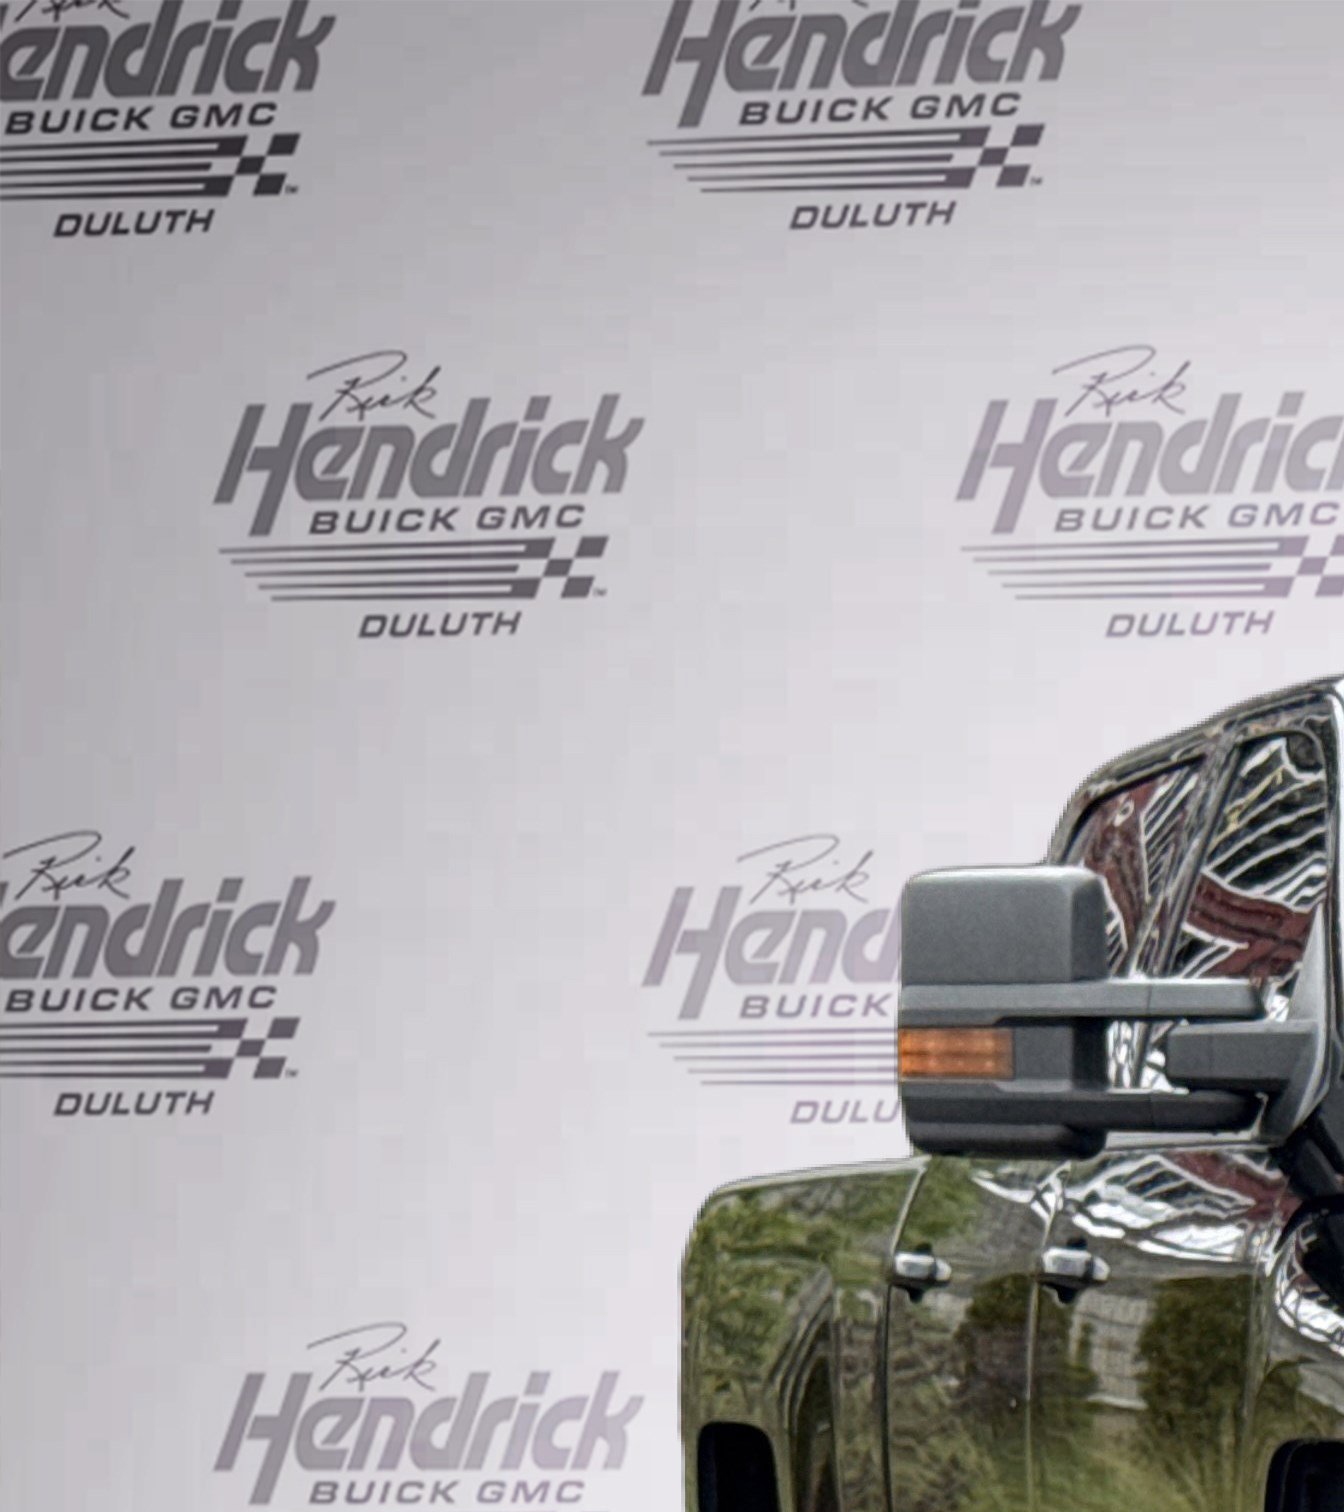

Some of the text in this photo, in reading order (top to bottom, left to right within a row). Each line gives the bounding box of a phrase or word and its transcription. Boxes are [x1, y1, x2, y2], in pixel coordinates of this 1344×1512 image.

[0, 0, 337, 101] endrick
[641, 0, 1082, 128] Hendrick
[4, 102, 278, 135] BUICK GMC
[738, 92, 1022, 126] BUICK GMC
[53, 208, 215, 237] DULUTH
[789, 200, 957, 230] DULUTH
[212, 393, 645, 537] Hendrick
[308, 504, 585, 536] BUICK GMC
[1053, 501, 1341, 533] BUICK GMC
[358, 610, 522, 639] DULUTH
[1105, 609, 1275, 638] DULUTH
[0, 876, 337, 980] endrick
[640, 885, 902, 1021] Hend
[4, 985, 278, 1012] BUICK GMC
[738, 993, 893, 1020] BUICK
[53, 1090, 215, 1117] DULUTH
[789, 1099, 902, 1125] DULU
[212, 1369, 646, 1506] Hendrick
[308, 1479, 587, 1505] BUICK GMC
